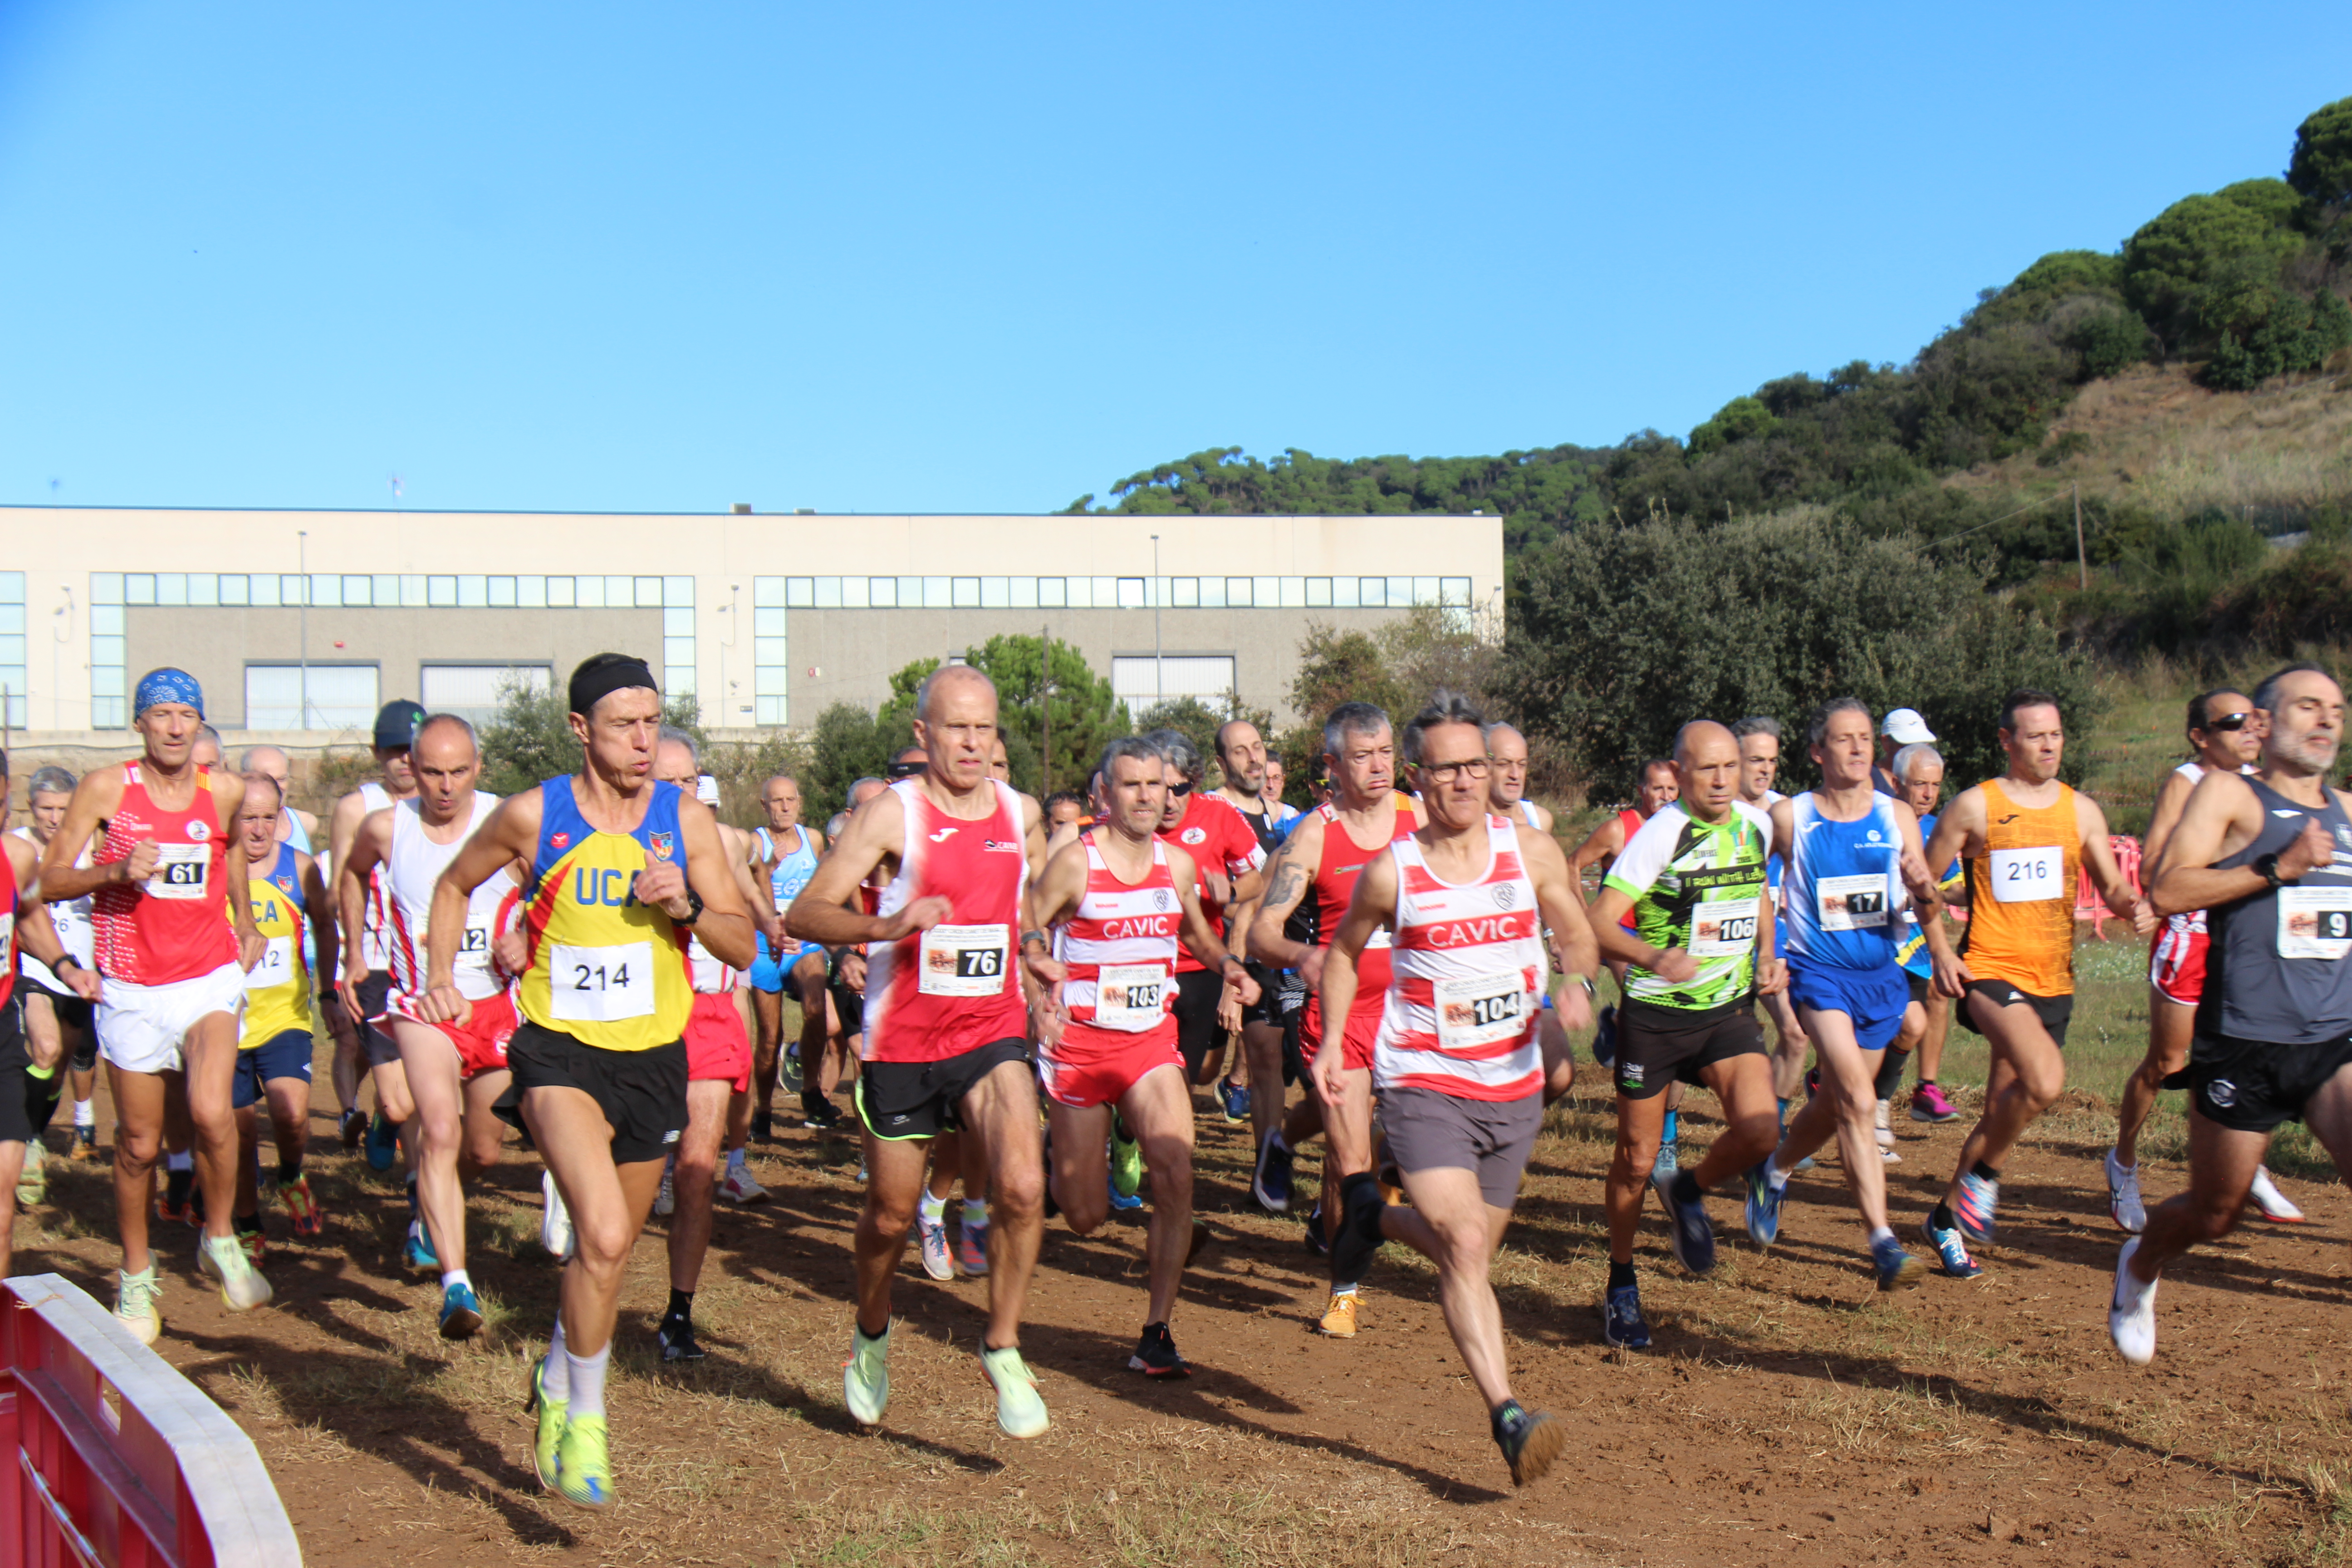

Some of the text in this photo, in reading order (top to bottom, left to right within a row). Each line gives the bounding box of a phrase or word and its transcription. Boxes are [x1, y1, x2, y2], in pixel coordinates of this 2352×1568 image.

[172, 864, 195, 883] 61
[2008, 860, 2047, 881] 216
[1852, 893, 1877, 912] 17
[1103, 916, 1168, 939] CAVIC
[1427, 916, 1518, 947] CAVIC
[1720, 918, 1753, 940] 106
[2329, 912, 2347, 937] 9
[254, 950, 279, 970] 12
[965, 951, 997, 975] 76
[574, 962, 630, 991] 214
[1128, 985, 1158, 1007] 103
[1475, 992, 1520, 1024] 104
